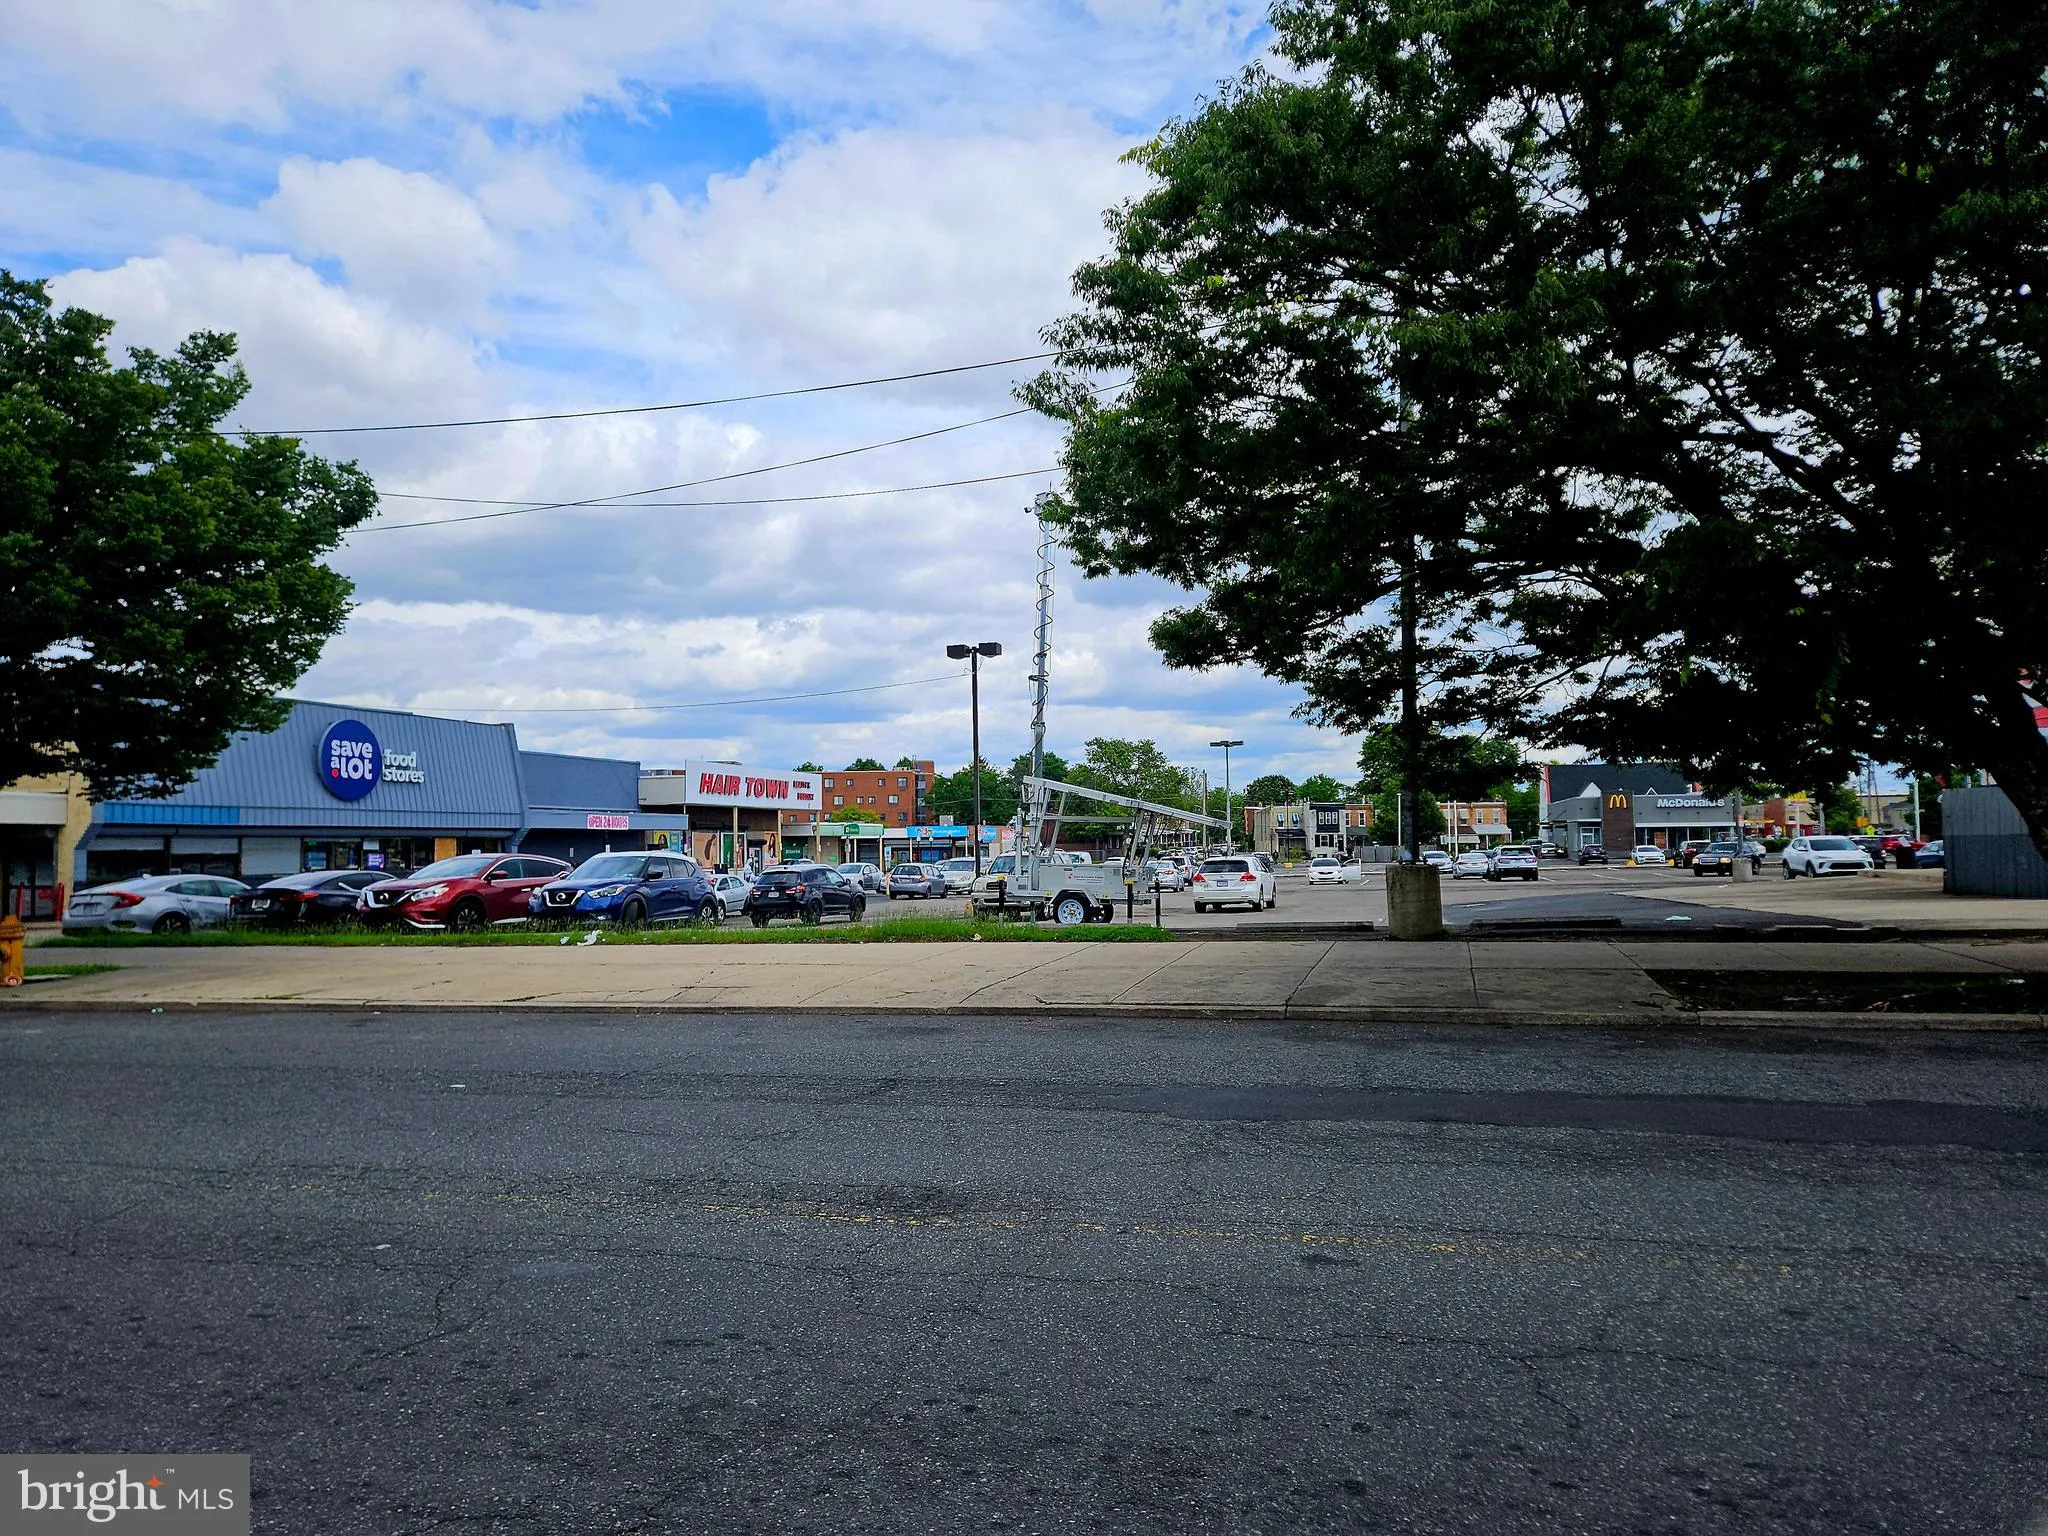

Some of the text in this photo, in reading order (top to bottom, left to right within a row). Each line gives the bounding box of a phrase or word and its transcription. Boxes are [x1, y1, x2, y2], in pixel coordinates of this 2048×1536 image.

[330, 739, 373, 759] save
[383, 749, 417, 768] food
[382, 766, 425, 783] stores
[699, 772, 790, 800] HAIR TOWN
